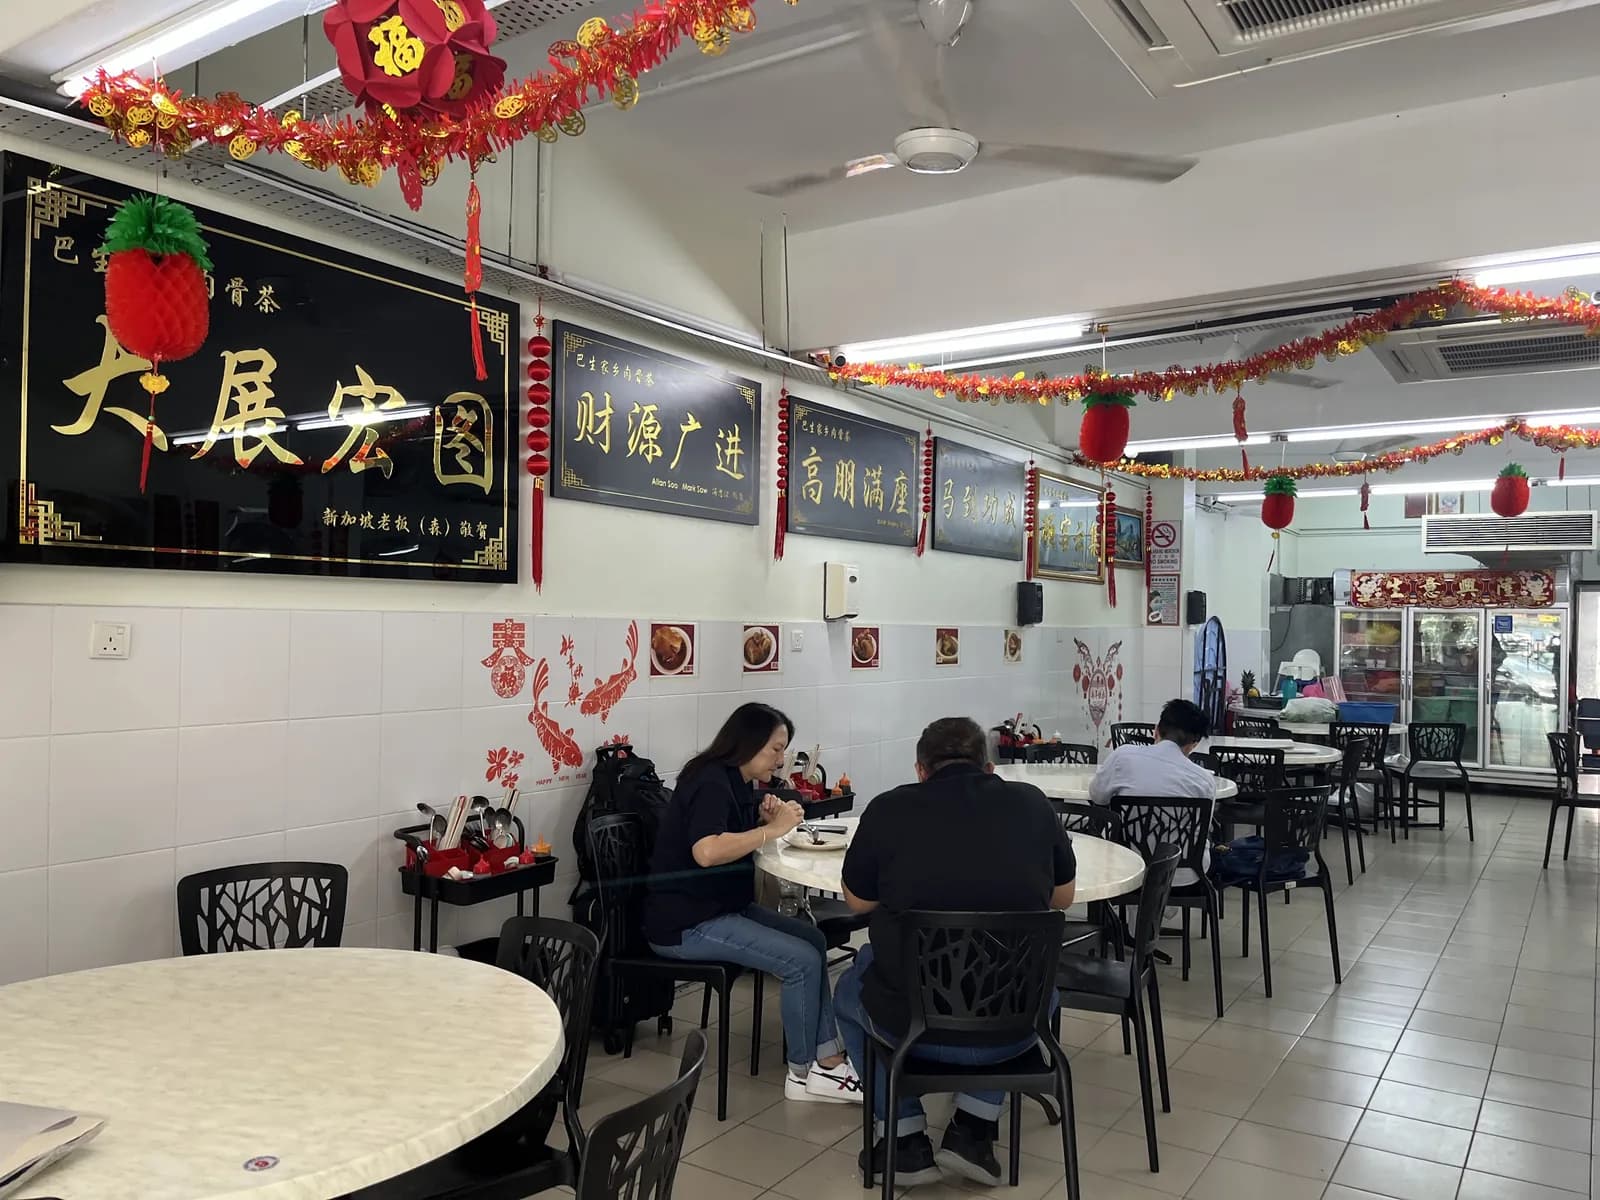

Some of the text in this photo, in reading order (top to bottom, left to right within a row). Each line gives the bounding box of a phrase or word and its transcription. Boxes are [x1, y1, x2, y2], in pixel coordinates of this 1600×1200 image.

[368, 15, 426, 77] 福
[50, 313, 494, 495] 大展宏图
[573, 390, 746, 481] 财源广进
[801, 446, 911, 515] 高朋满座
[1385, 576, 1517, 599] 生意興隆
